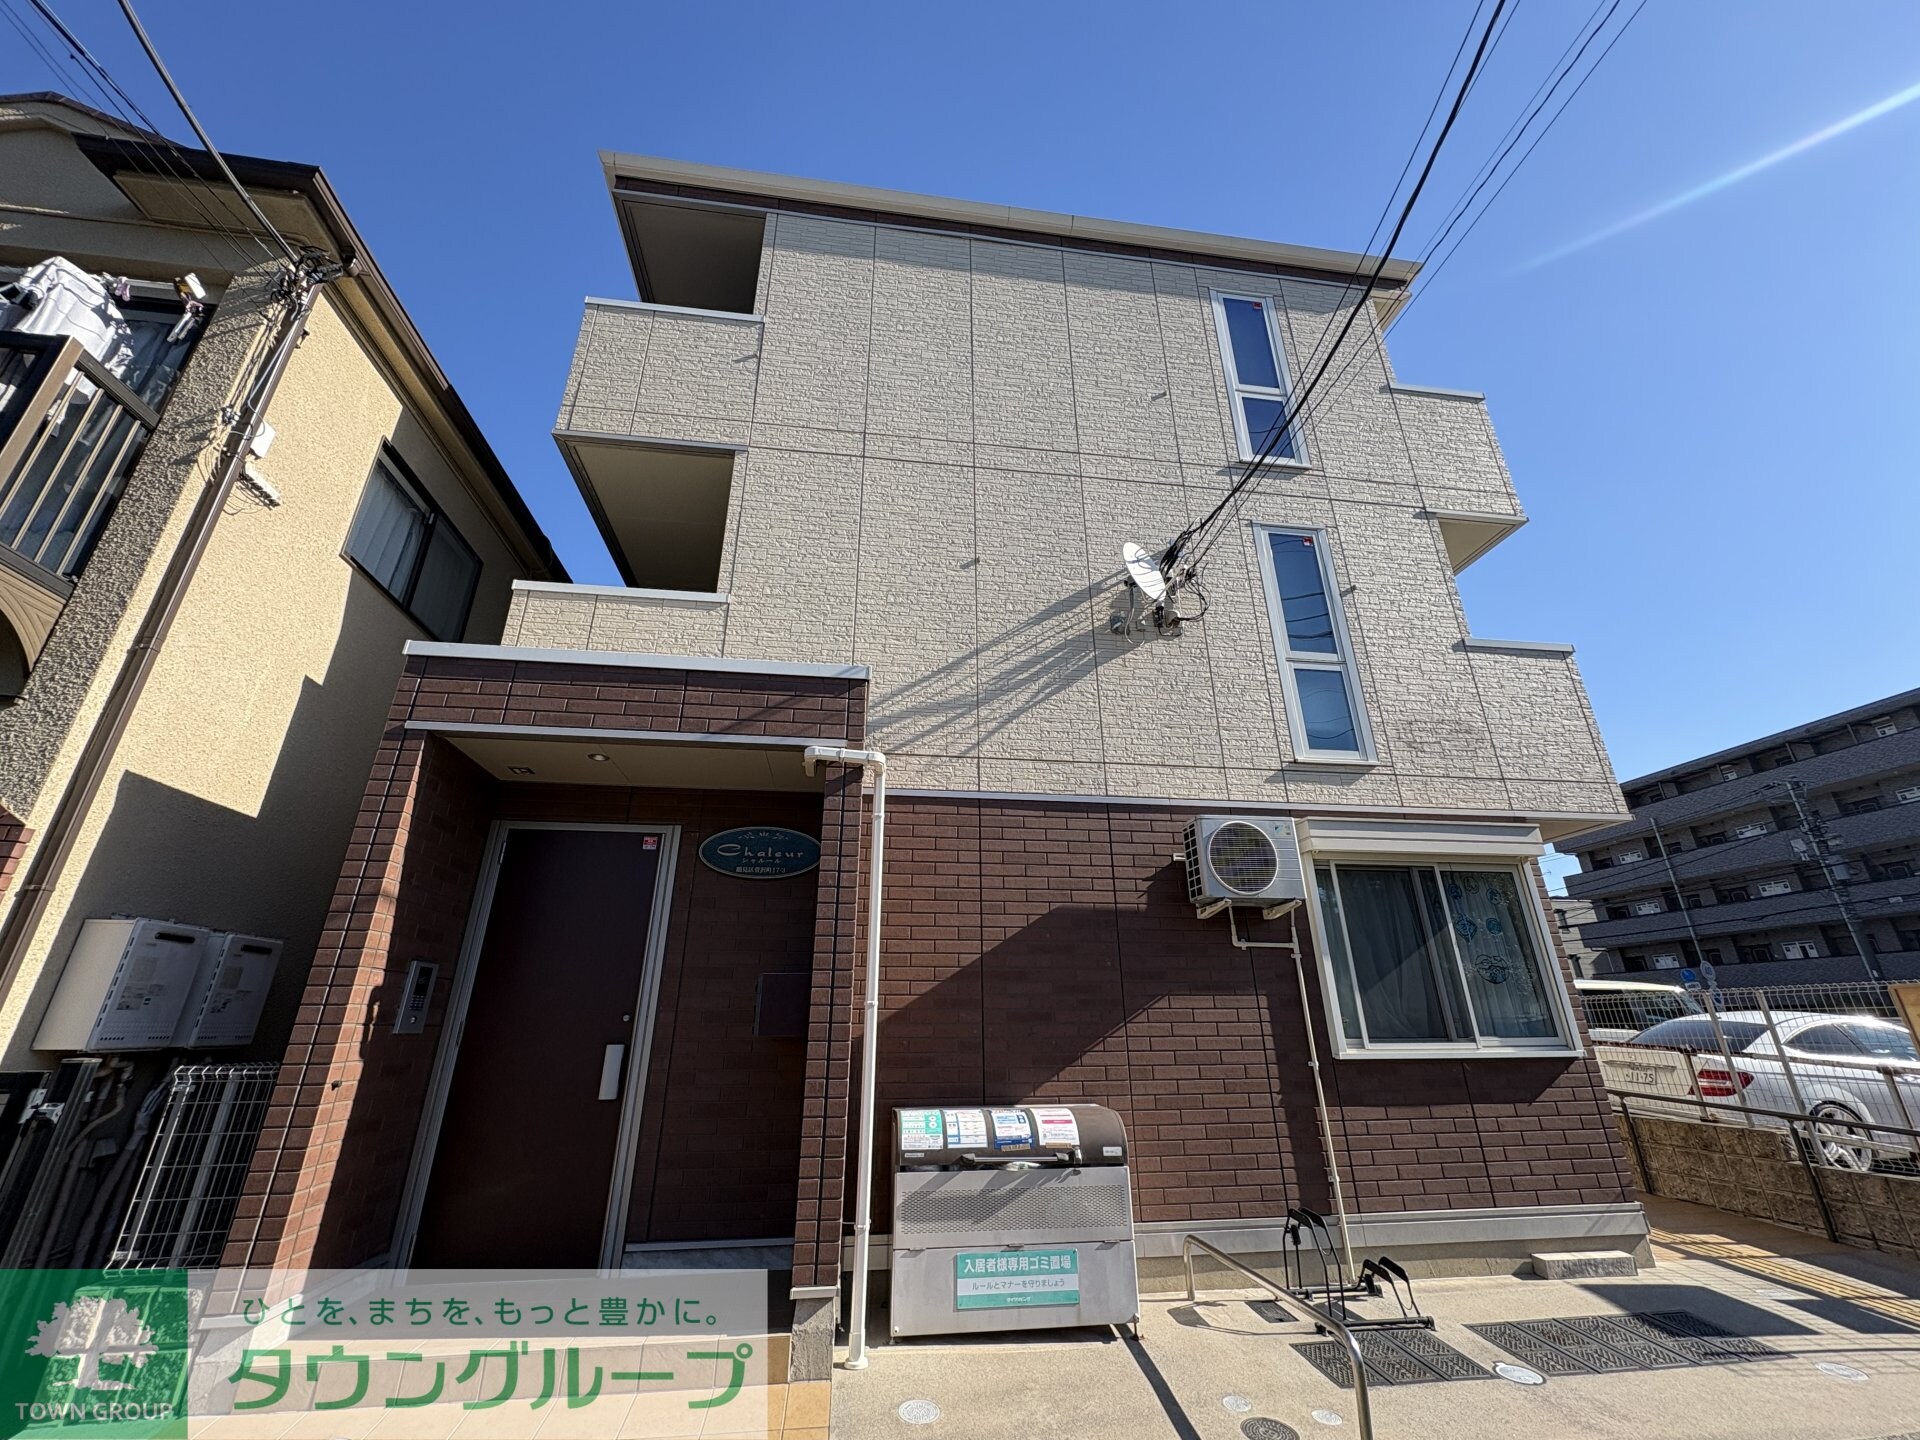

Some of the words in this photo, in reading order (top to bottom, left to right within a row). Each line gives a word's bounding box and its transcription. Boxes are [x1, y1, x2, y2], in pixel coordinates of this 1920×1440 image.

[717, 844, 804, 858] Chaleur
[964, 1255, 1071, 1273] 入居者様専用ゴミ置場
[972, 1278, 1065, 1290] ルールとマナーを守りましょう
